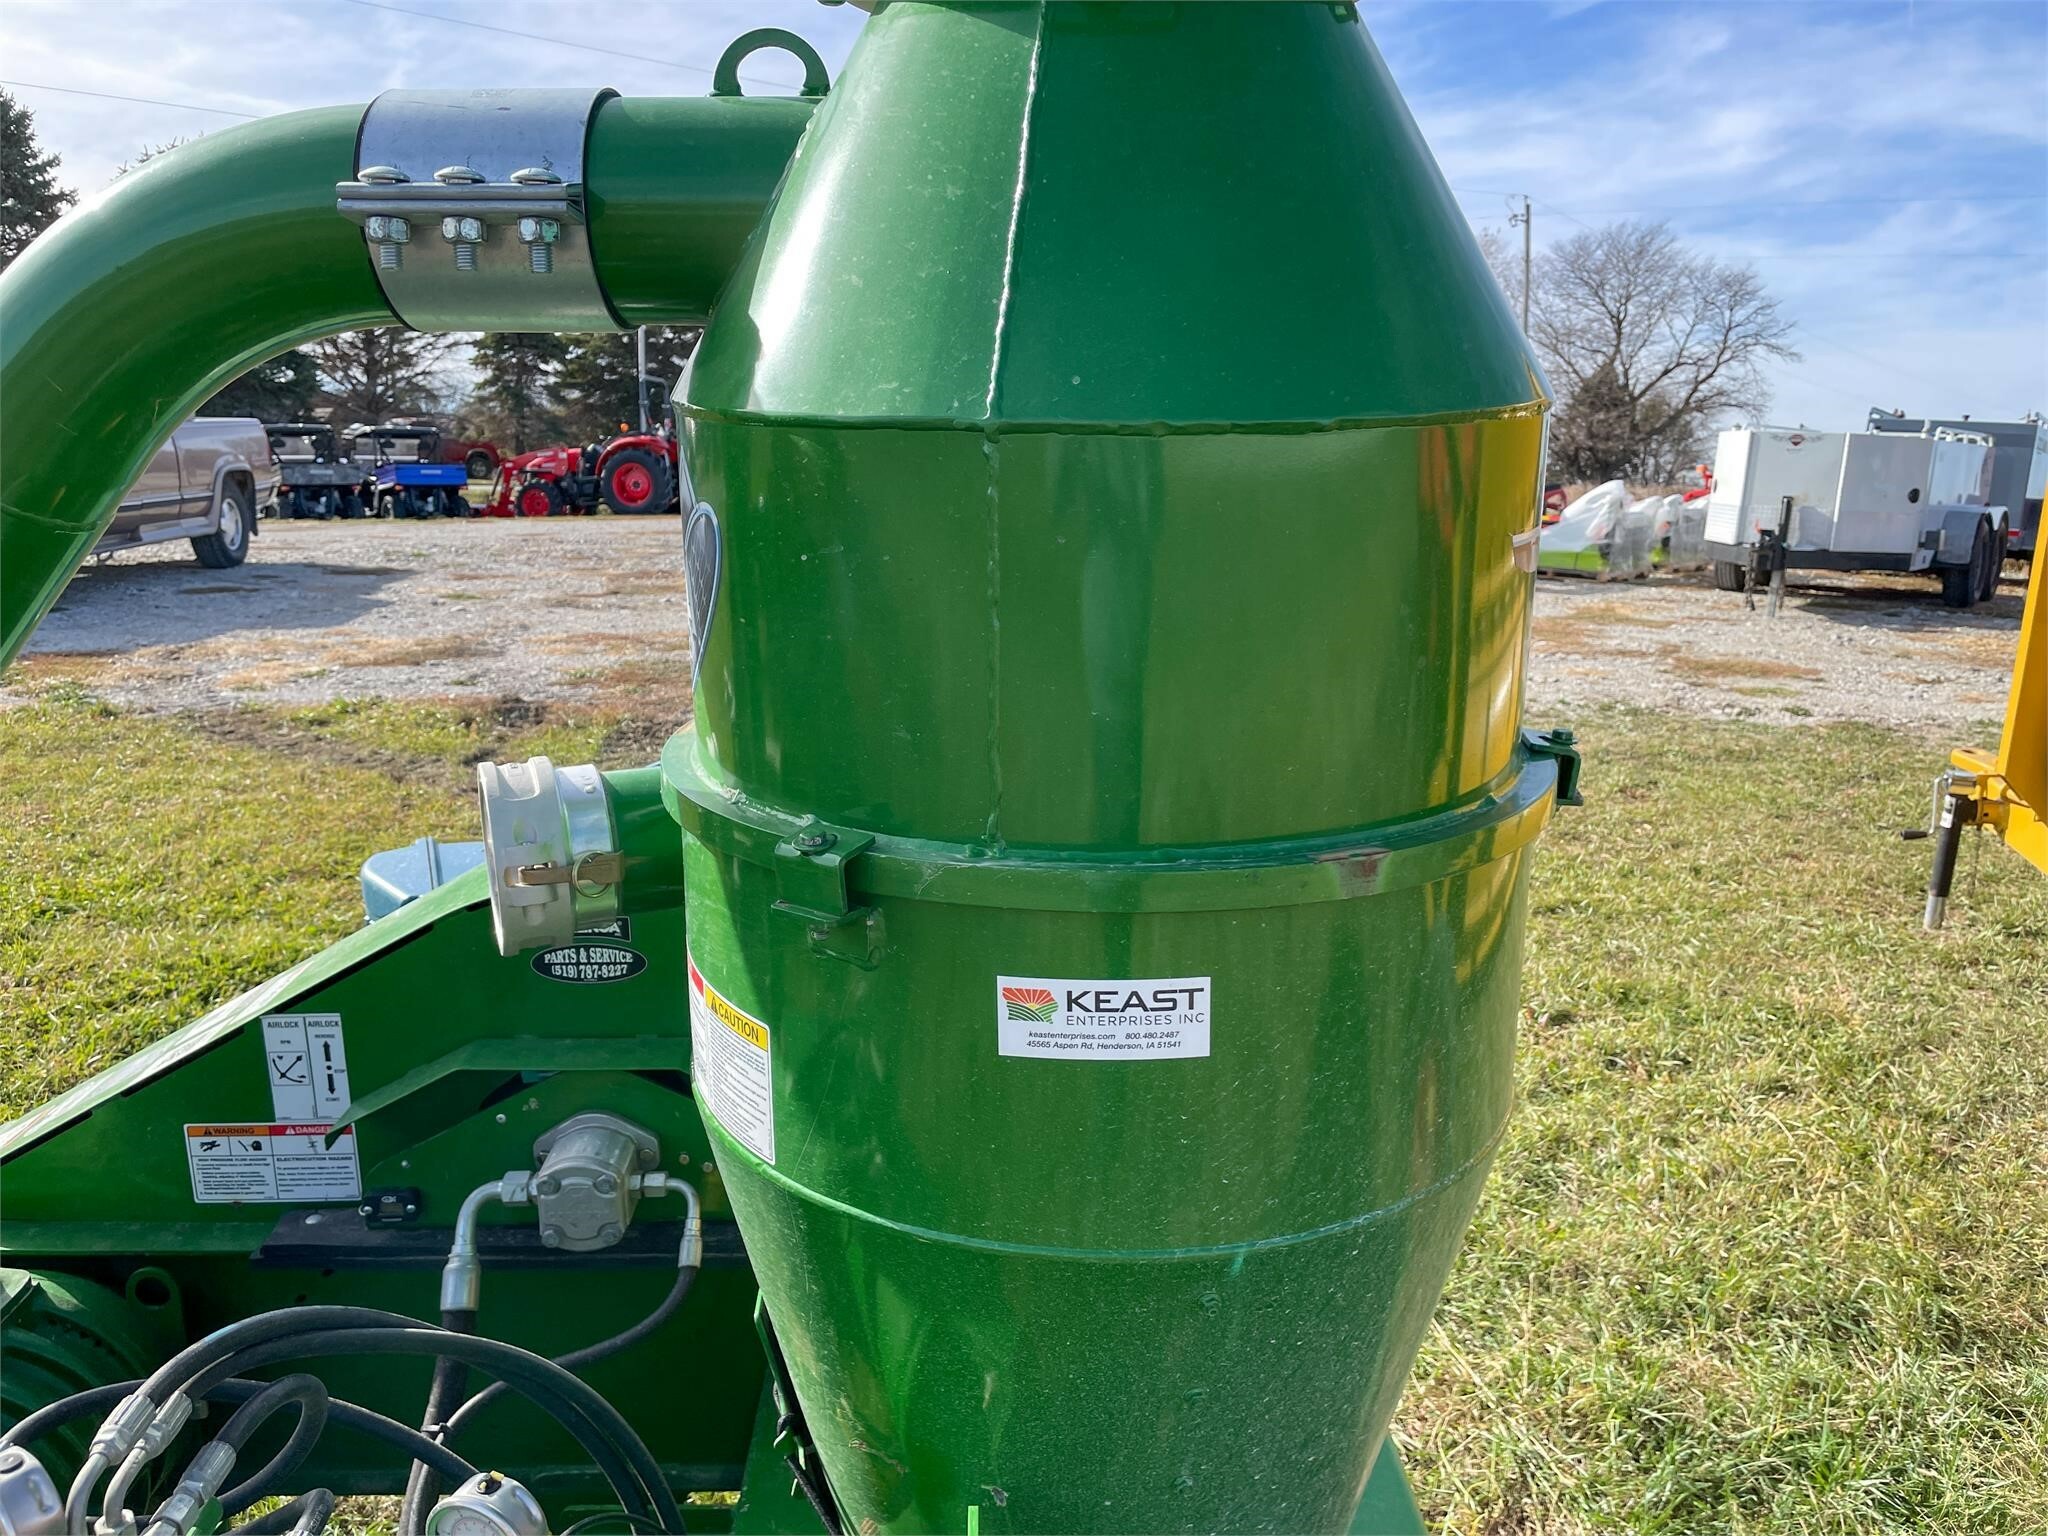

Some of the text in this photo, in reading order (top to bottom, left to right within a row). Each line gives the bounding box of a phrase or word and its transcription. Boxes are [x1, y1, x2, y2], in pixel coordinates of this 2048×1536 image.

[544, 948, 633, 964] PARTS & SERVICE
[552, 965, 578, 978] (519)
[1066, 988, 1205, 1013] KEAST
[308, 1020, 340, 1028] AIRLOCK
[717, 1002, 760, 1042] CAUTION
[1066, 1013, 1205, 1026] ENTERPRISES INC
[1028, 1031, 1180, 1040] keastenterprises.com 800.480.2487
[1026, 1041, 1181, 1050] 45565 Aspen Rd, Henderson, IA 51541
